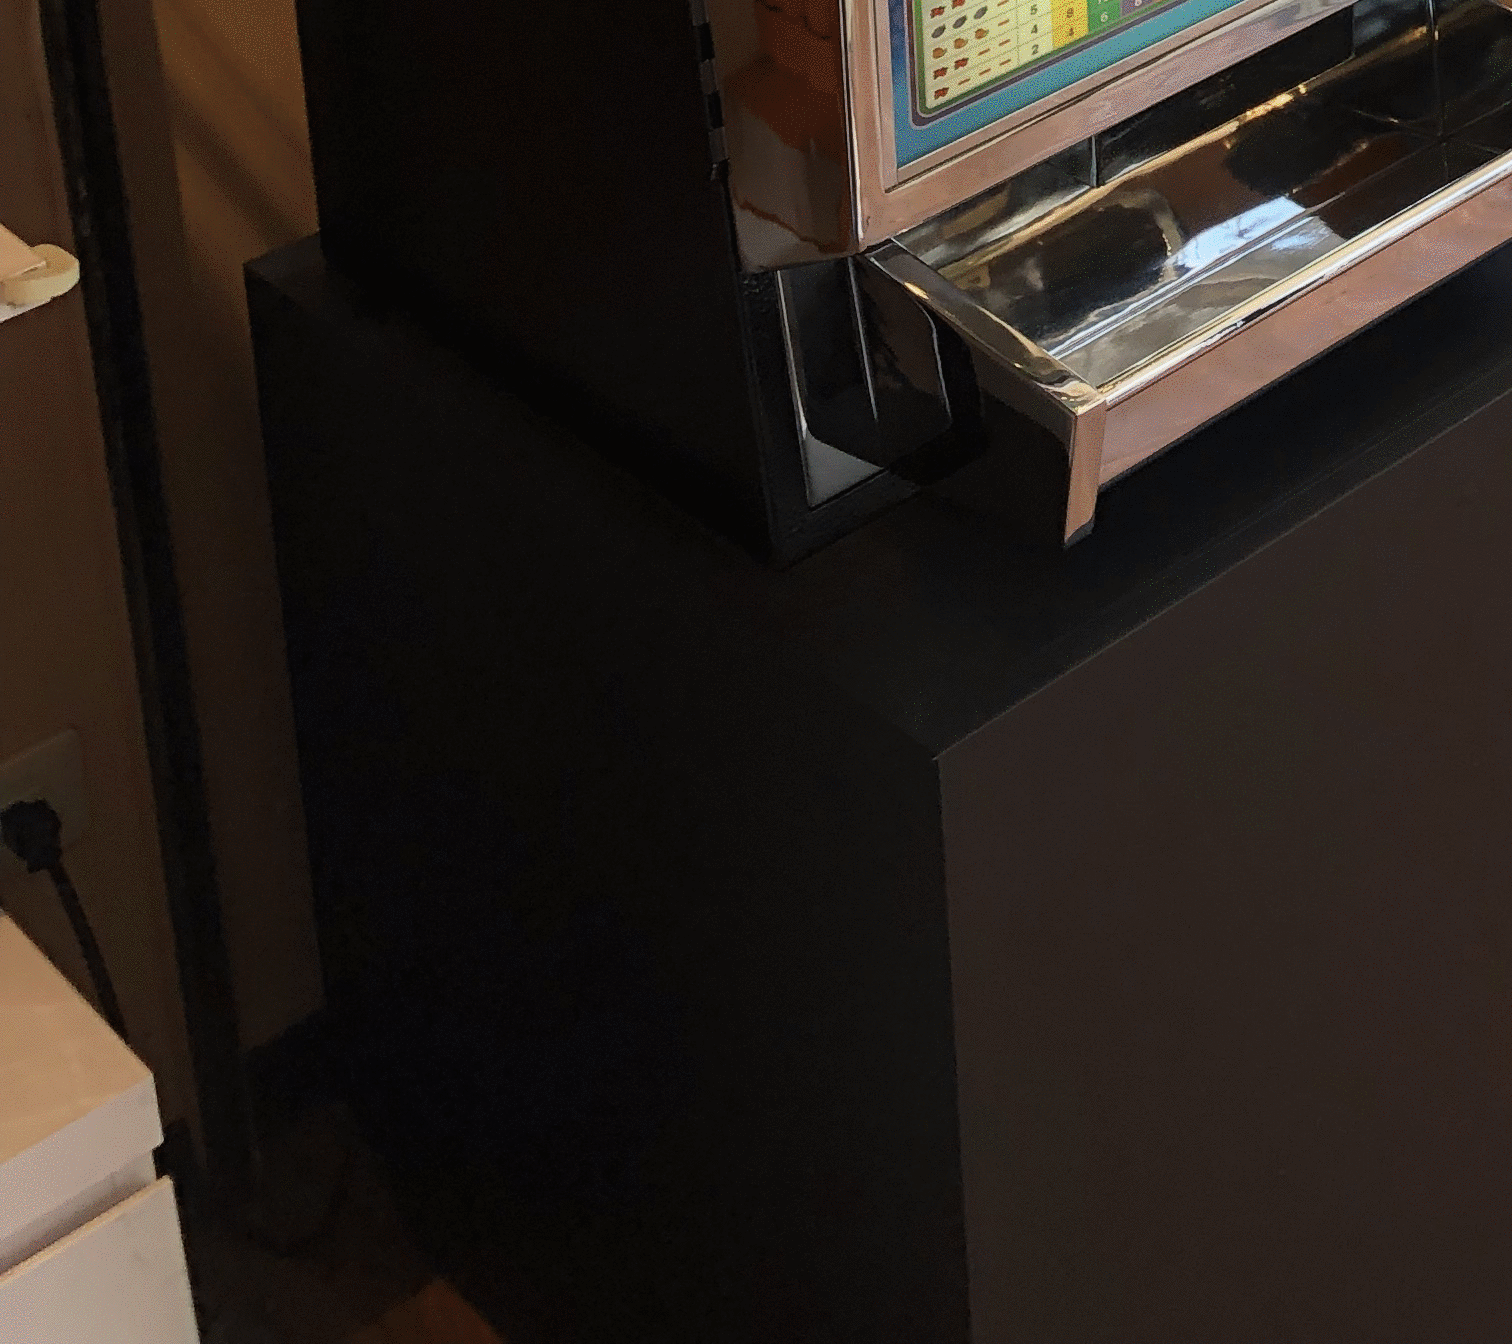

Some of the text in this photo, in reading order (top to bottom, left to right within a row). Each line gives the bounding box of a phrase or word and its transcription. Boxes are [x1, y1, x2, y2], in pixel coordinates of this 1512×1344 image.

[1030, 4, 1038, 15] 5
[1031, 24, 1038, 35] 4
[1031, 44, 1039, 56] 2
